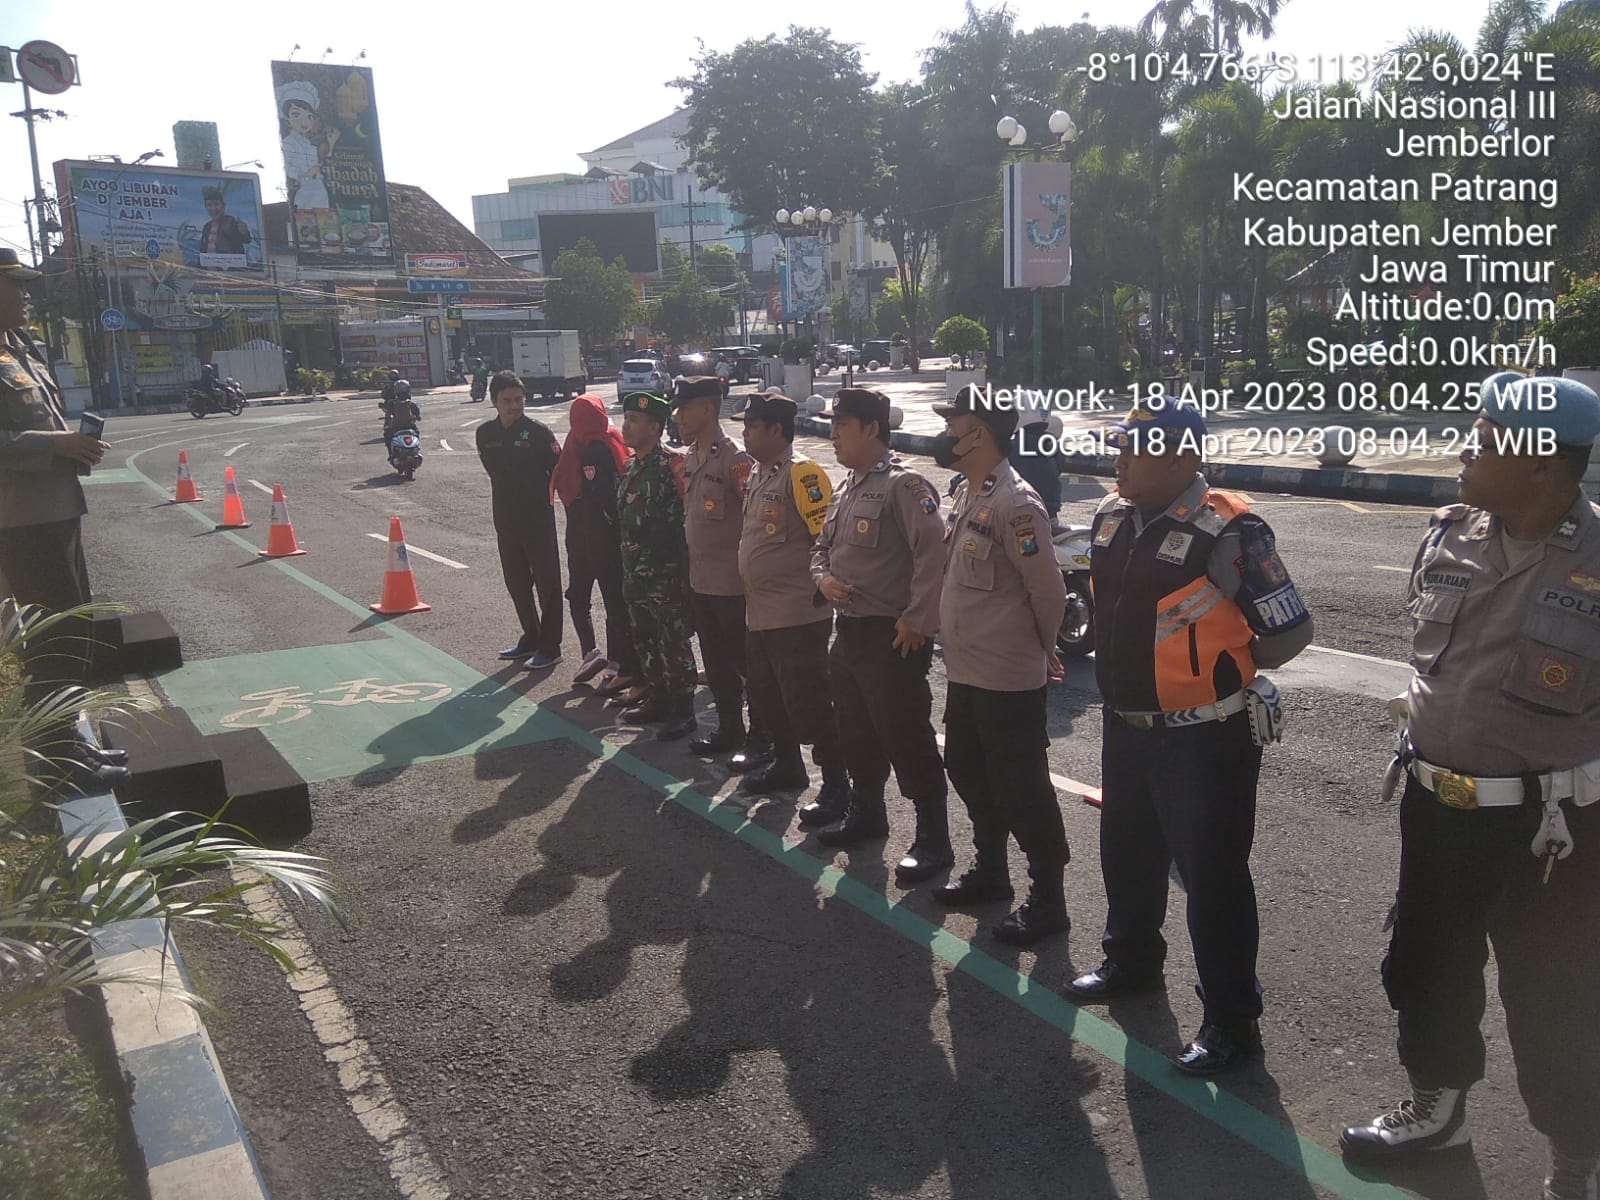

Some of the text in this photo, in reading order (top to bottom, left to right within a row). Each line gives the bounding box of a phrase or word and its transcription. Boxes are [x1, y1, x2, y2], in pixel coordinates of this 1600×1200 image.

[81, 178, 179, 196] AYOO LIBURAN
[631, 174, 674, 204] BNI
[116, 195, 169, 209] JEMBER
[119, 208, 145, 221] AJA
[861, 492, 885, 500] POLRI
[967, 520, 992, 537] POLRI
